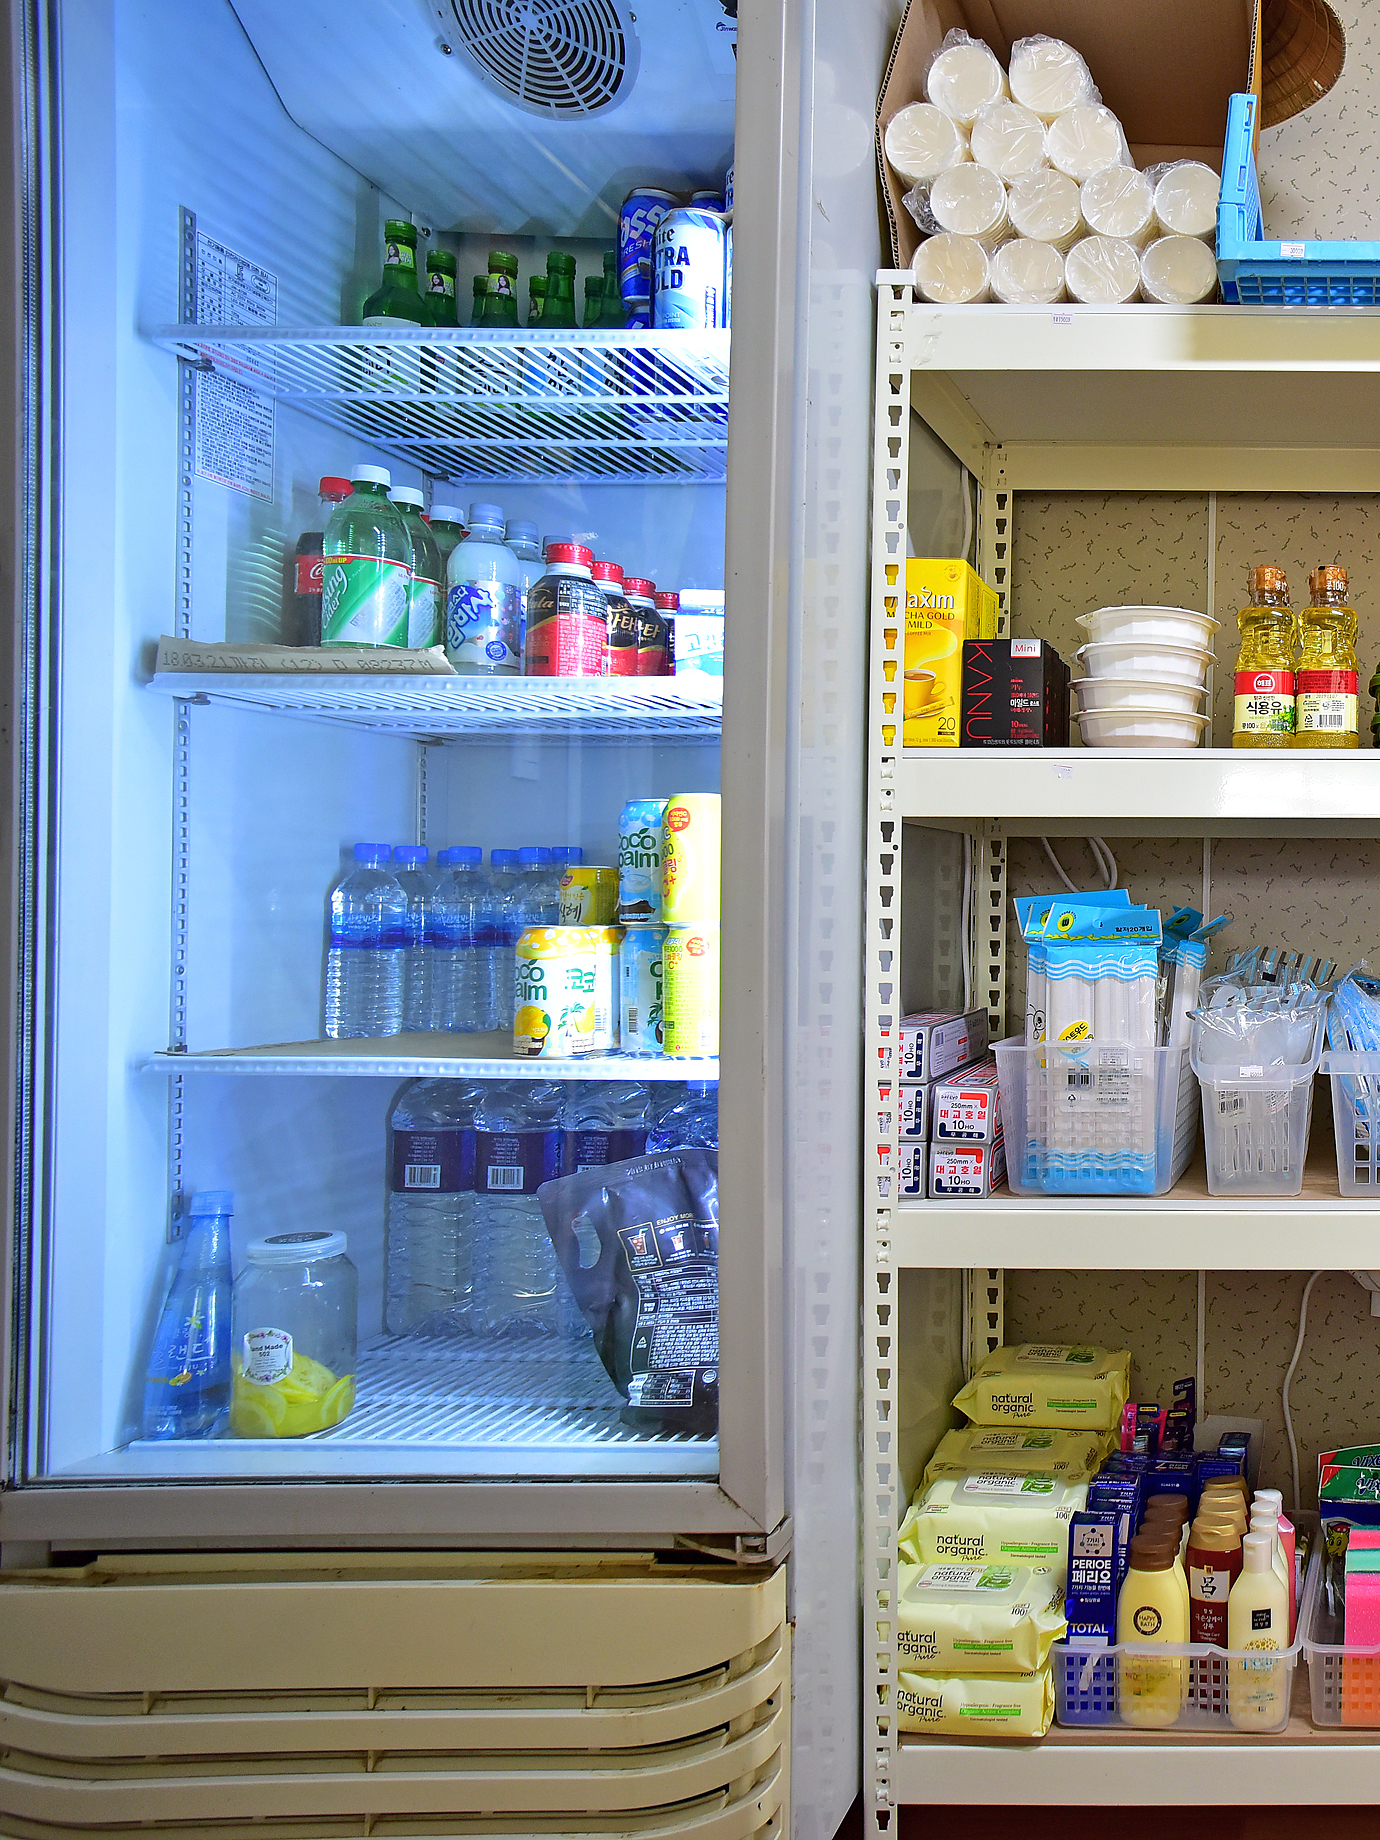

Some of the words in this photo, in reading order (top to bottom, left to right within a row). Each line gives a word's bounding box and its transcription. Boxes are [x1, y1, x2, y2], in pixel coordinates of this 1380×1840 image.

[906, 586, 954, 610] axim
[904, 611, 924, 620] CHA
[926, 611, 955, 621] GOLD
[907, 620, 933, 630] MILD
[1014, 642, 1036, 654] Mini
[966, 642, 994, 740] KANU
[1246, 700, 1283, 716] 식용유
[937, 716, 956, 730] 20
[1010, 720, 1020, 728] 10
[950, 1102, 974, 1110] 250mm
[946, 1158, 969, 1166] 250mm
[656, 1214, 679, 1226] ENJOY
[991, 1392, 1033, 1404] natural
[991, 1403, 1034, 1414] organic
[1012, 1412, 1032, 1420] Pure
[936, 1534, 984, 1547] natural
[936, 1545, 986, 1557] organic
[960, 1554, 983, 1562] Pure
[1072, 1559, 1112, 1570] PERIOE
[931, 1574, 974, 1582] organic
[1071, 1570, 1112, 1584] 페리오
[1138, 1614, 1156, 1622] HAPPY
[1070, 1622, 1109, 1634] TOTAL
[898, 1630, 936, 1644] atural
[898, 1642, 938, 1654] rganic
[913, 1654, 936, 1662] Pure
[897, 1690, 944, 1708] natural
[897, 1700, 944, 1718] organic
